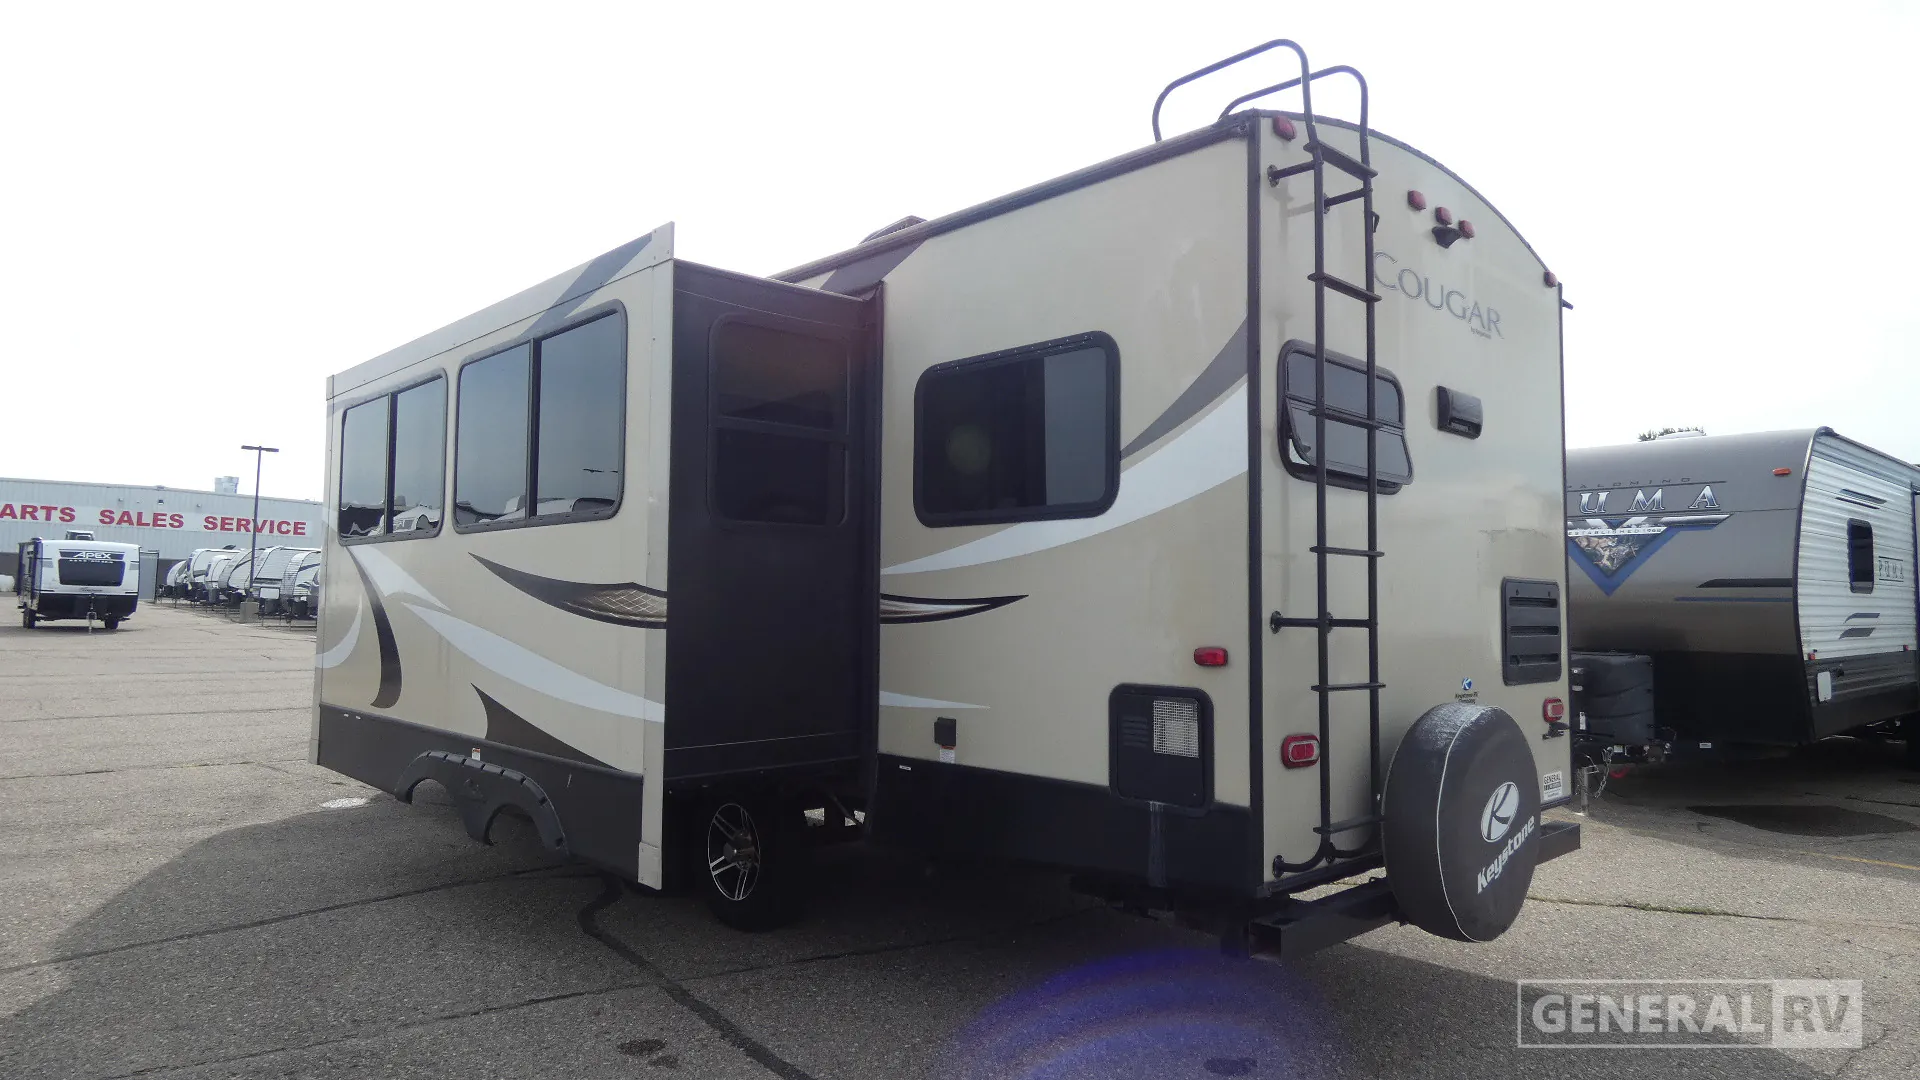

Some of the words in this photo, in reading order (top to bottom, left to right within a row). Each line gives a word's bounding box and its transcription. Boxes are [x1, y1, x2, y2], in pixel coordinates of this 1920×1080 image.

[1373, 251, 1504, 339] COUGAR
[1580, 485, 1720, 514] UMA
[0, 503, 76, 523] ARTS
[99, 509, 184, 529] SALES
[203, 515, 307, 536] SERVICE
[74, 552, 111, 560] APEX
[1477, 815, 1535, 894] Keystone
